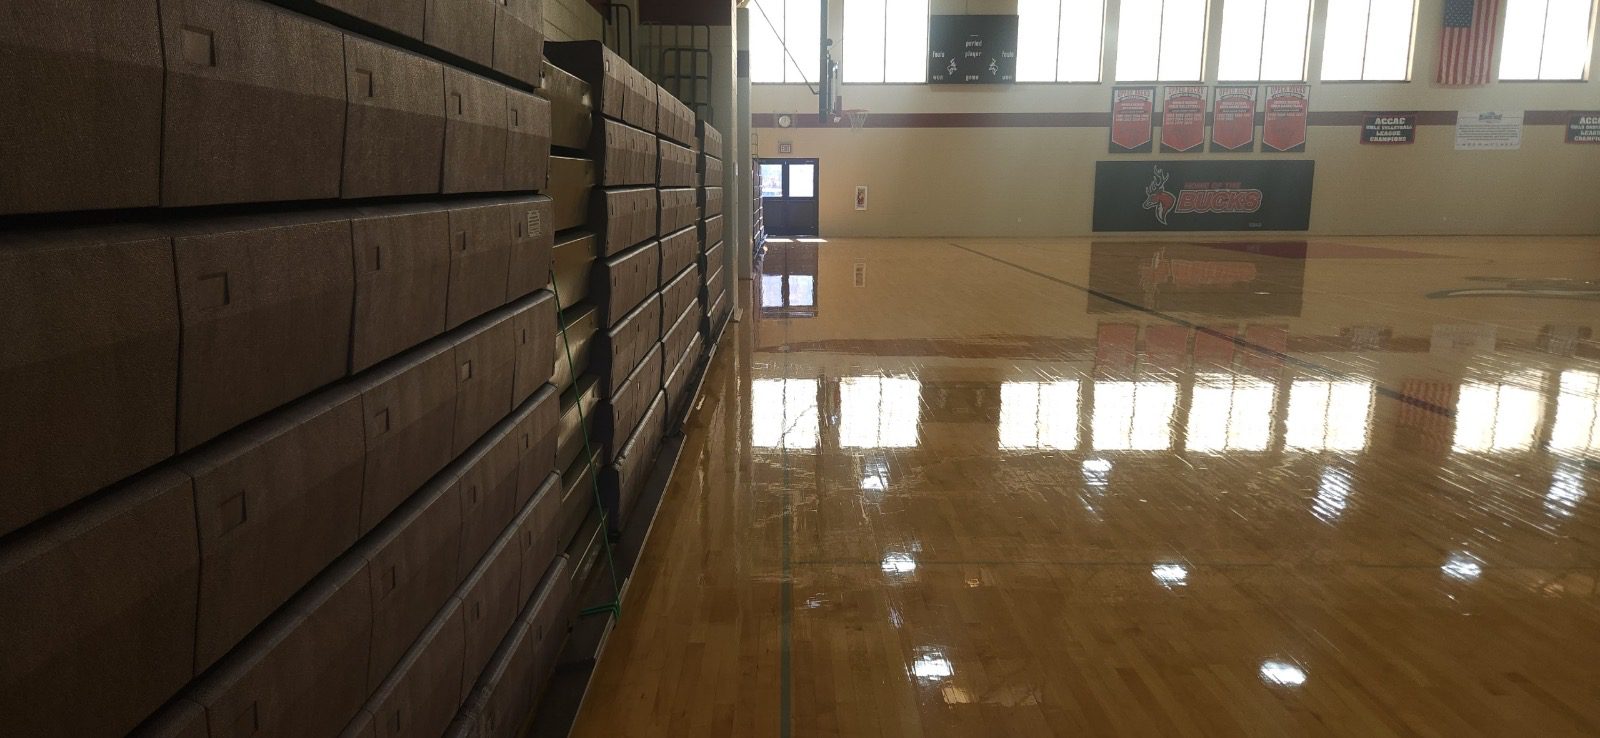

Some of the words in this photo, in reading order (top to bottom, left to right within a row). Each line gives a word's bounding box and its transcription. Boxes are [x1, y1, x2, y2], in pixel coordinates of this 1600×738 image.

[965, 40, 982, 48] period
[964, 50, 982, 58] player
[1375, 117, 1406, 125] ACCAC
[1176, 190, 1261, 212] BUCKS
